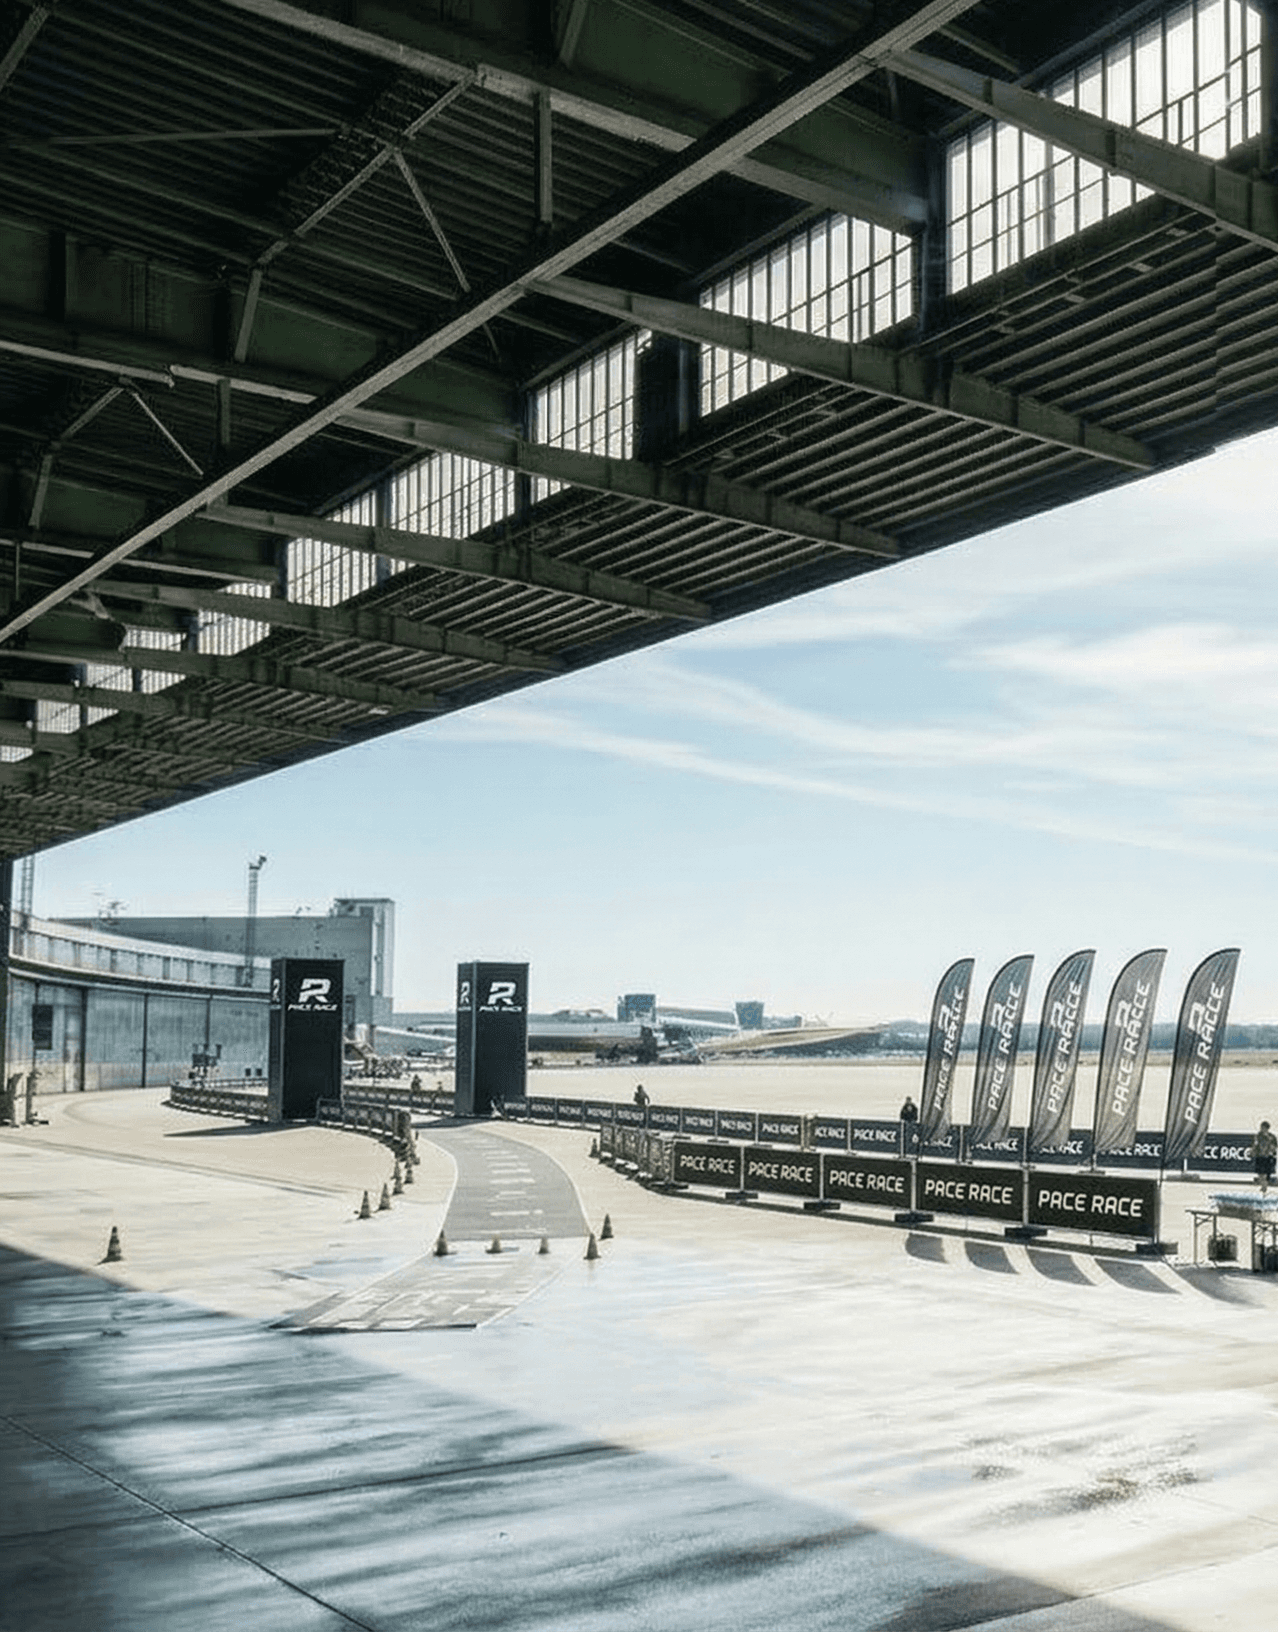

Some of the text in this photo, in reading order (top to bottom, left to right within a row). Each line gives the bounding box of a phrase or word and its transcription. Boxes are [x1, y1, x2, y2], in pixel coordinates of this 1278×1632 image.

[298, 978, 331, 1003] R
[487, 981, 516, 1005] R
[988, 981, 1022, 1111] PACE RACE
[1047, 980, 1082, 1113] PACE RACE
[1112, 979, 1150, 1116] PACE RACE
[1184, 982, 1225, 1124] PACE RACE
[680, 1155, 736, 1174] PACE RACE
[748, 1161, 814, 1183] PACE RACE
[829, 1170, 905, 1193] PACE RACE
[924, 1179, 1014, 1205] PACE RACE
[1037, 1189, 1143, 1218] PACE RACE
